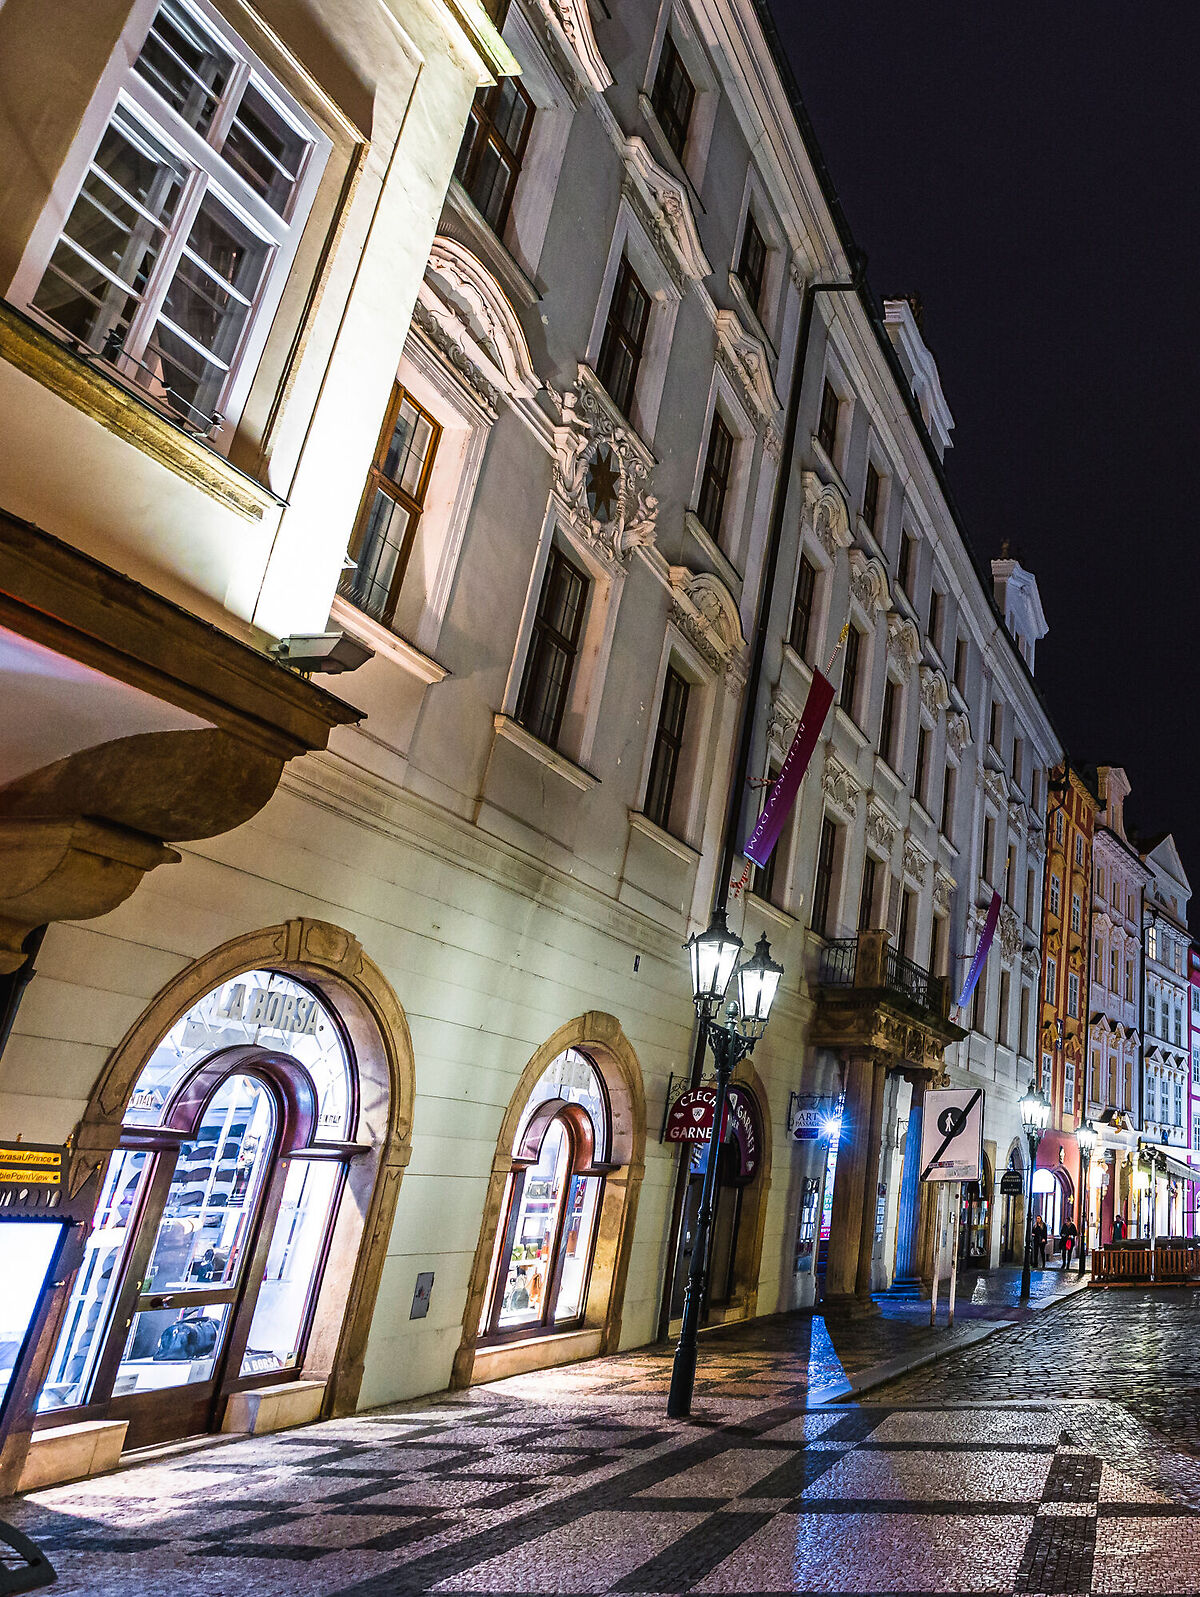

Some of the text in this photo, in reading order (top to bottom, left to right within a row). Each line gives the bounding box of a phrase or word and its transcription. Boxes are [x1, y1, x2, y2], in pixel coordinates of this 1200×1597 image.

[216, 983, 319, 1035] LA BORSA
[799, 1112, 819, 1121] ART
[670, 1126, 713, 1139] GARNE
[251, 1356, 280, 1371] BORSA
